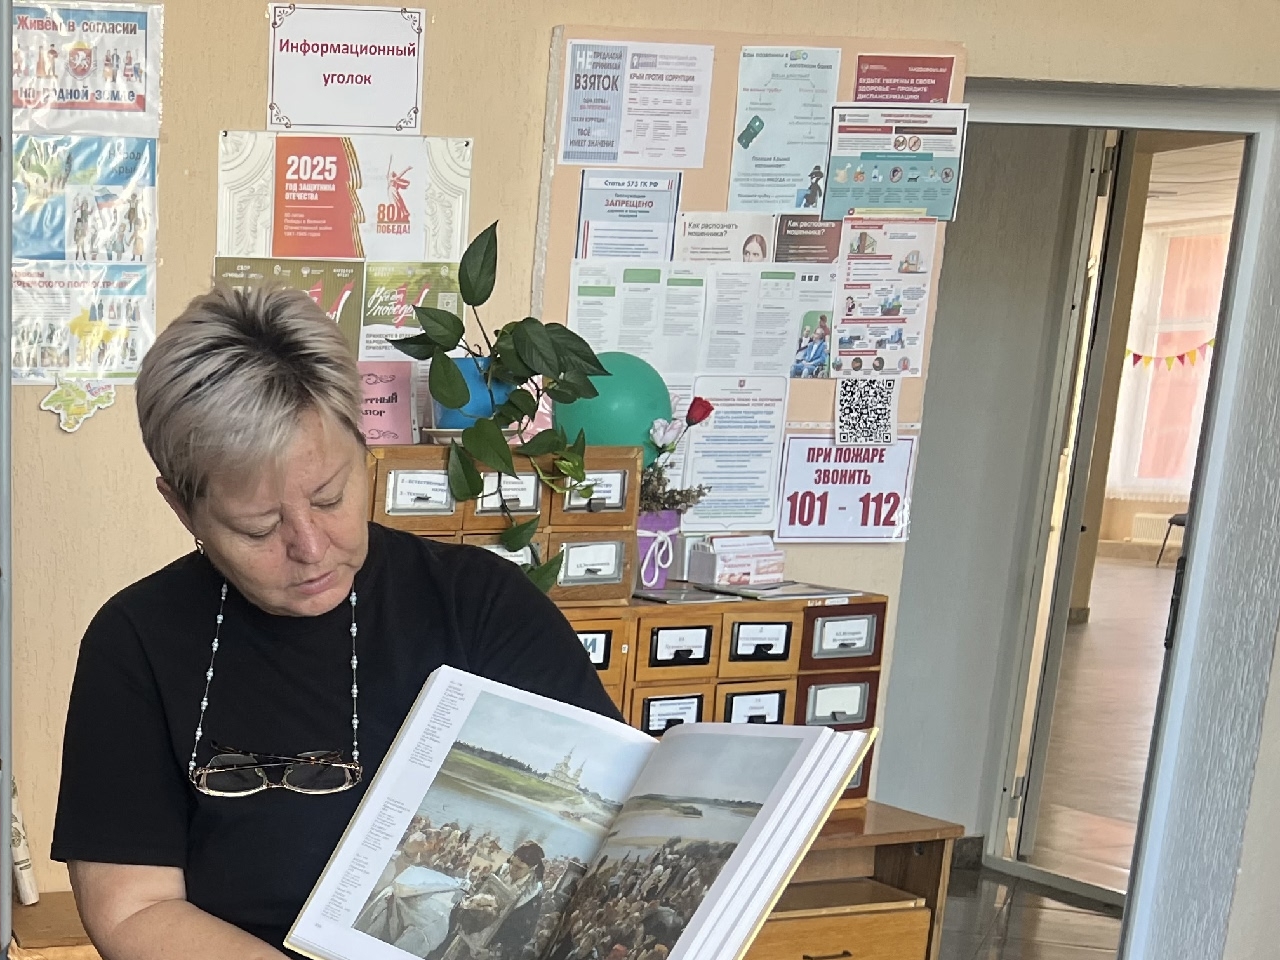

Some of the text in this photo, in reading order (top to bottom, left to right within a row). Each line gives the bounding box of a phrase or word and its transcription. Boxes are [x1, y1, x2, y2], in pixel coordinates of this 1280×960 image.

[68, 23, 76, 32] в
[81, 21, 137, 35] согласии
[279, 38, 416, 58] Информационный
[576, 50, 593, 70] НЕ
[322, 71, 372, 87] уголок
[574, 73, 619, 91] ВЗЯТОК
[285, 155, 338, 181] 2025
[285, 183, 336, 193] ГОД ЗАЩИТНИКА
[284, 192, 318, 200] ОТЕЧЕСТВА
[604, 199, 654, 209] ЗАПРЕЩЕНО
[376, 224, 411, 235] ПОБЕДА!
[687, 222, 739, 230] Как распознать
[786, 219, 836, 229] Как распознать
[687, 230, 728, 238] мошенника?
[786, 228, 826, 237] мошенника?
[806, 447, 886, 464] ПРИ ПОЖАРЕ
[814, 469, 872, 485] ЗВОНИТЬ
[786, 490, 829, 527] 101
[858, 492, 901, 527] 112
